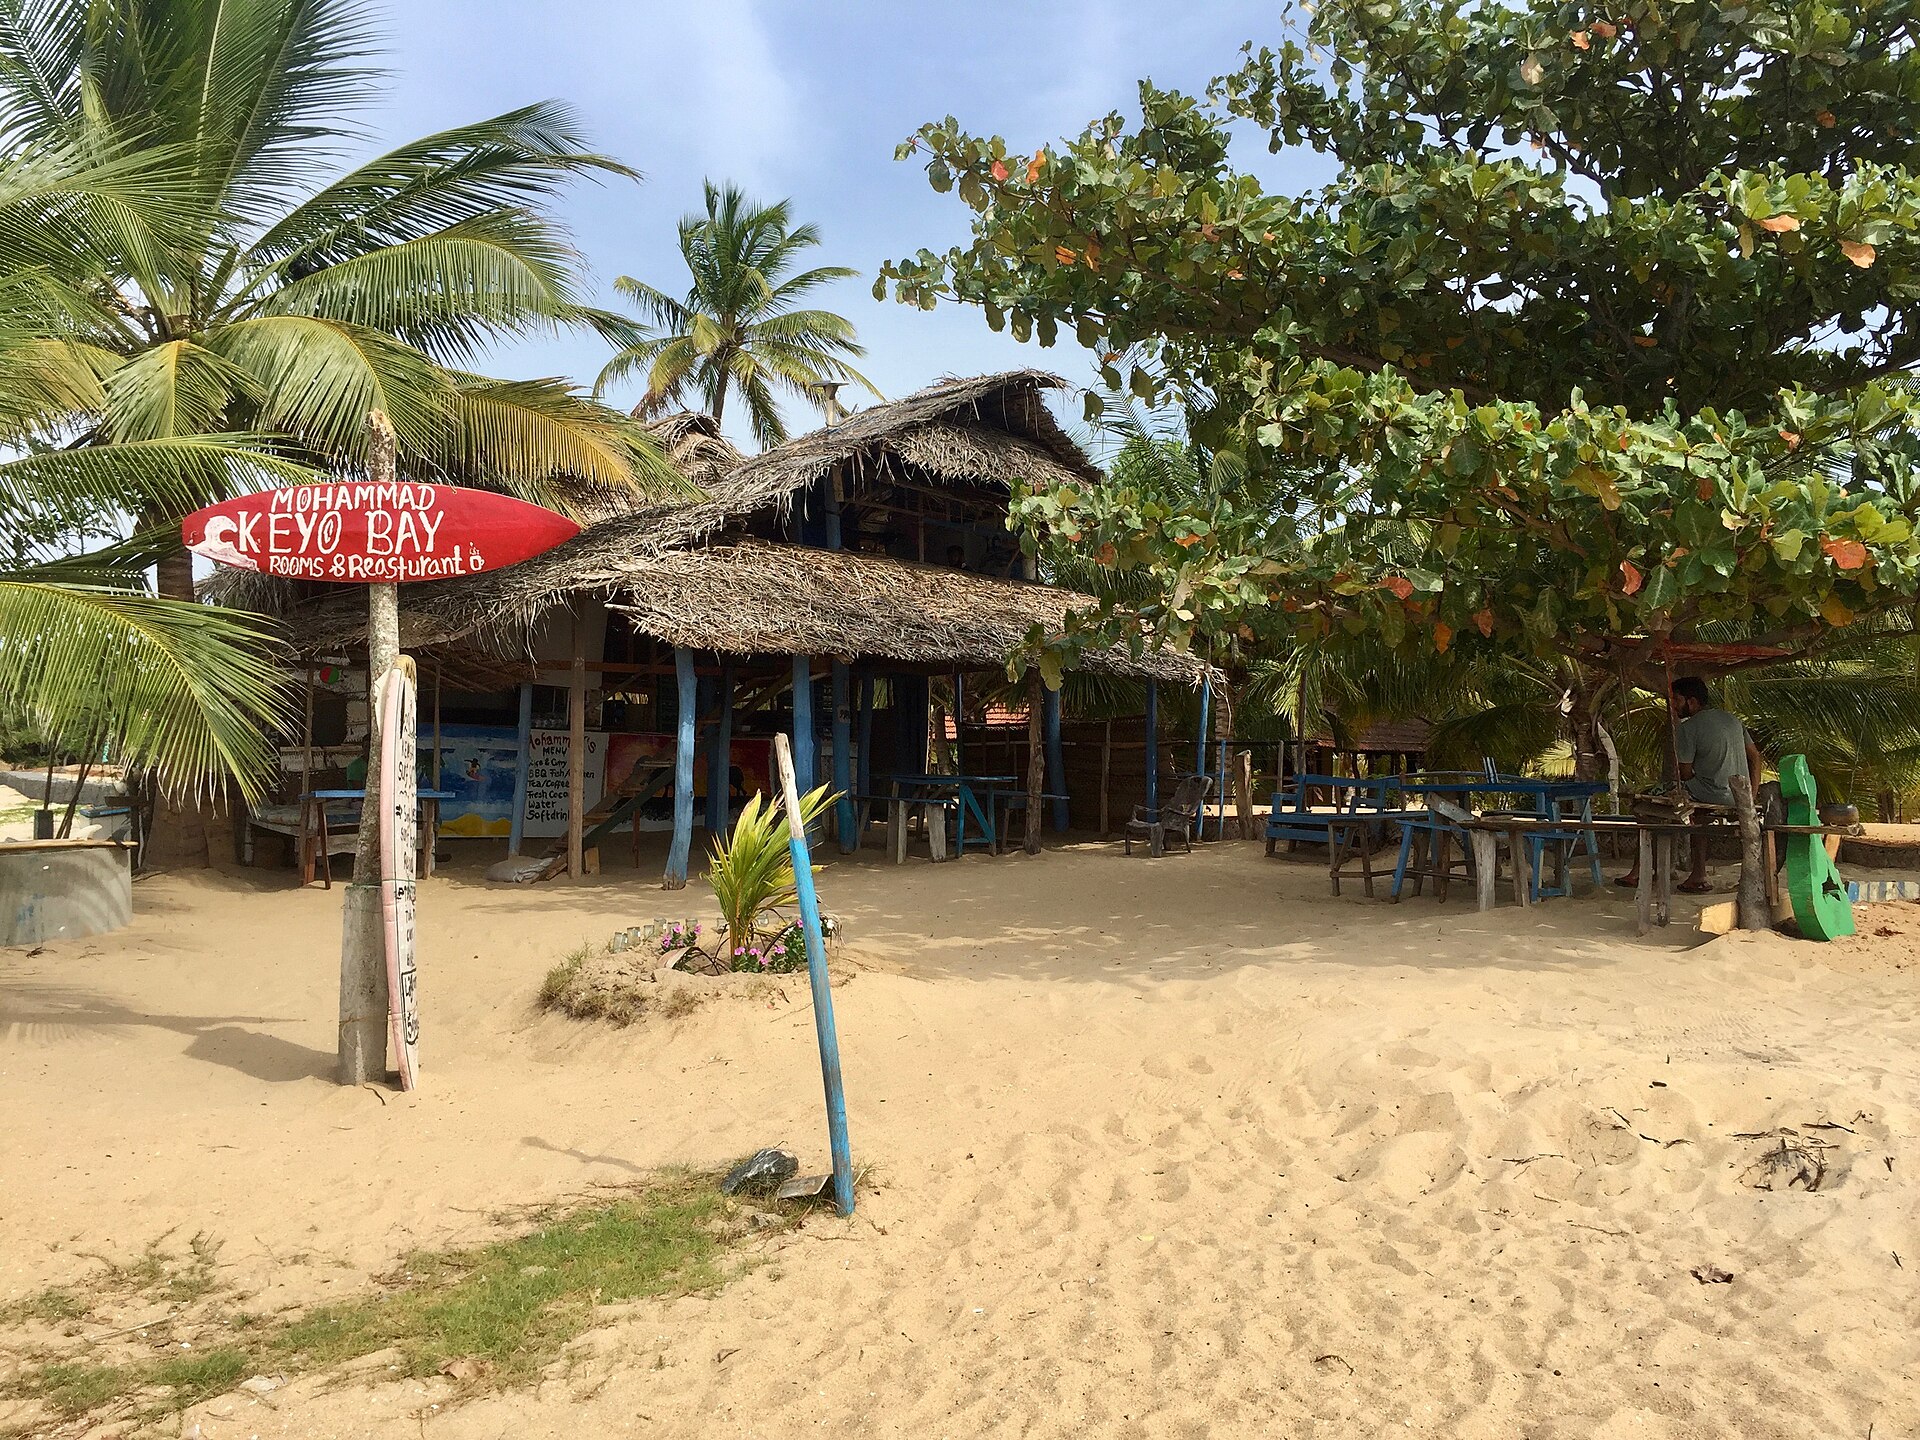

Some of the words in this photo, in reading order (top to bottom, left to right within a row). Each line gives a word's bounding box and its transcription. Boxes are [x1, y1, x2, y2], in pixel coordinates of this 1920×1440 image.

[271, 485, 436, 512] MOHAMMAD
[237, 511, 342, 554] KEYO
[366, 509, 444, 555] BAY
[269, 554, 324, 575] ROOMS
[543, 747, 568, 757] MENU
[528, 769, 547, 778] BBQ
[526, 790, 548, 799] Fresh
